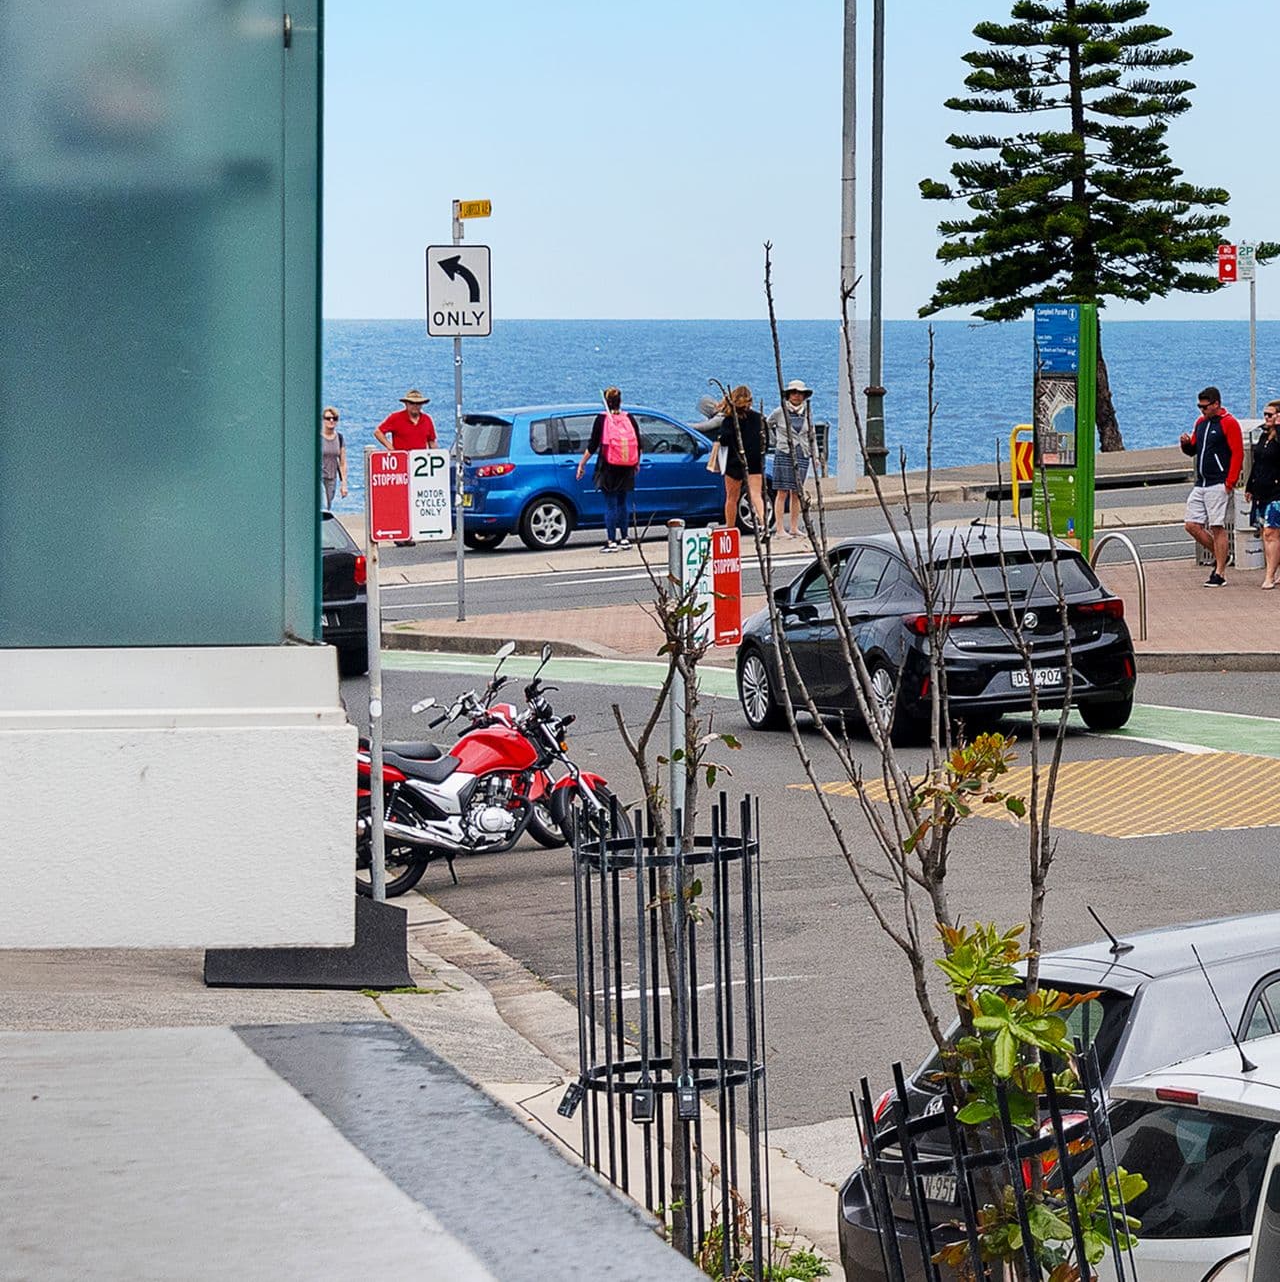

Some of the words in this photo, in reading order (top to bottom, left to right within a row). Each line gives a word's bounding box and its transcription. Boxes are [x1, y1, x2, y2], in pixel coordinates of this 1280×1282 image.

[1238, 246, 1254, 256] 2P
[433, 311, 485, 326] ONLY
[382, 456, 398, 471] NO
[414, 456, 445, 477] 2P
[372, 473, 409, 487] STOPPING
[417, 489, 444, 498] MOTOR
[415, 499, 447, 508] CYCLES
[420, 508, 442, 517] ONLY
[719, 536, 732, 554] NO
[713, 558, 740, 575] STOPPING
